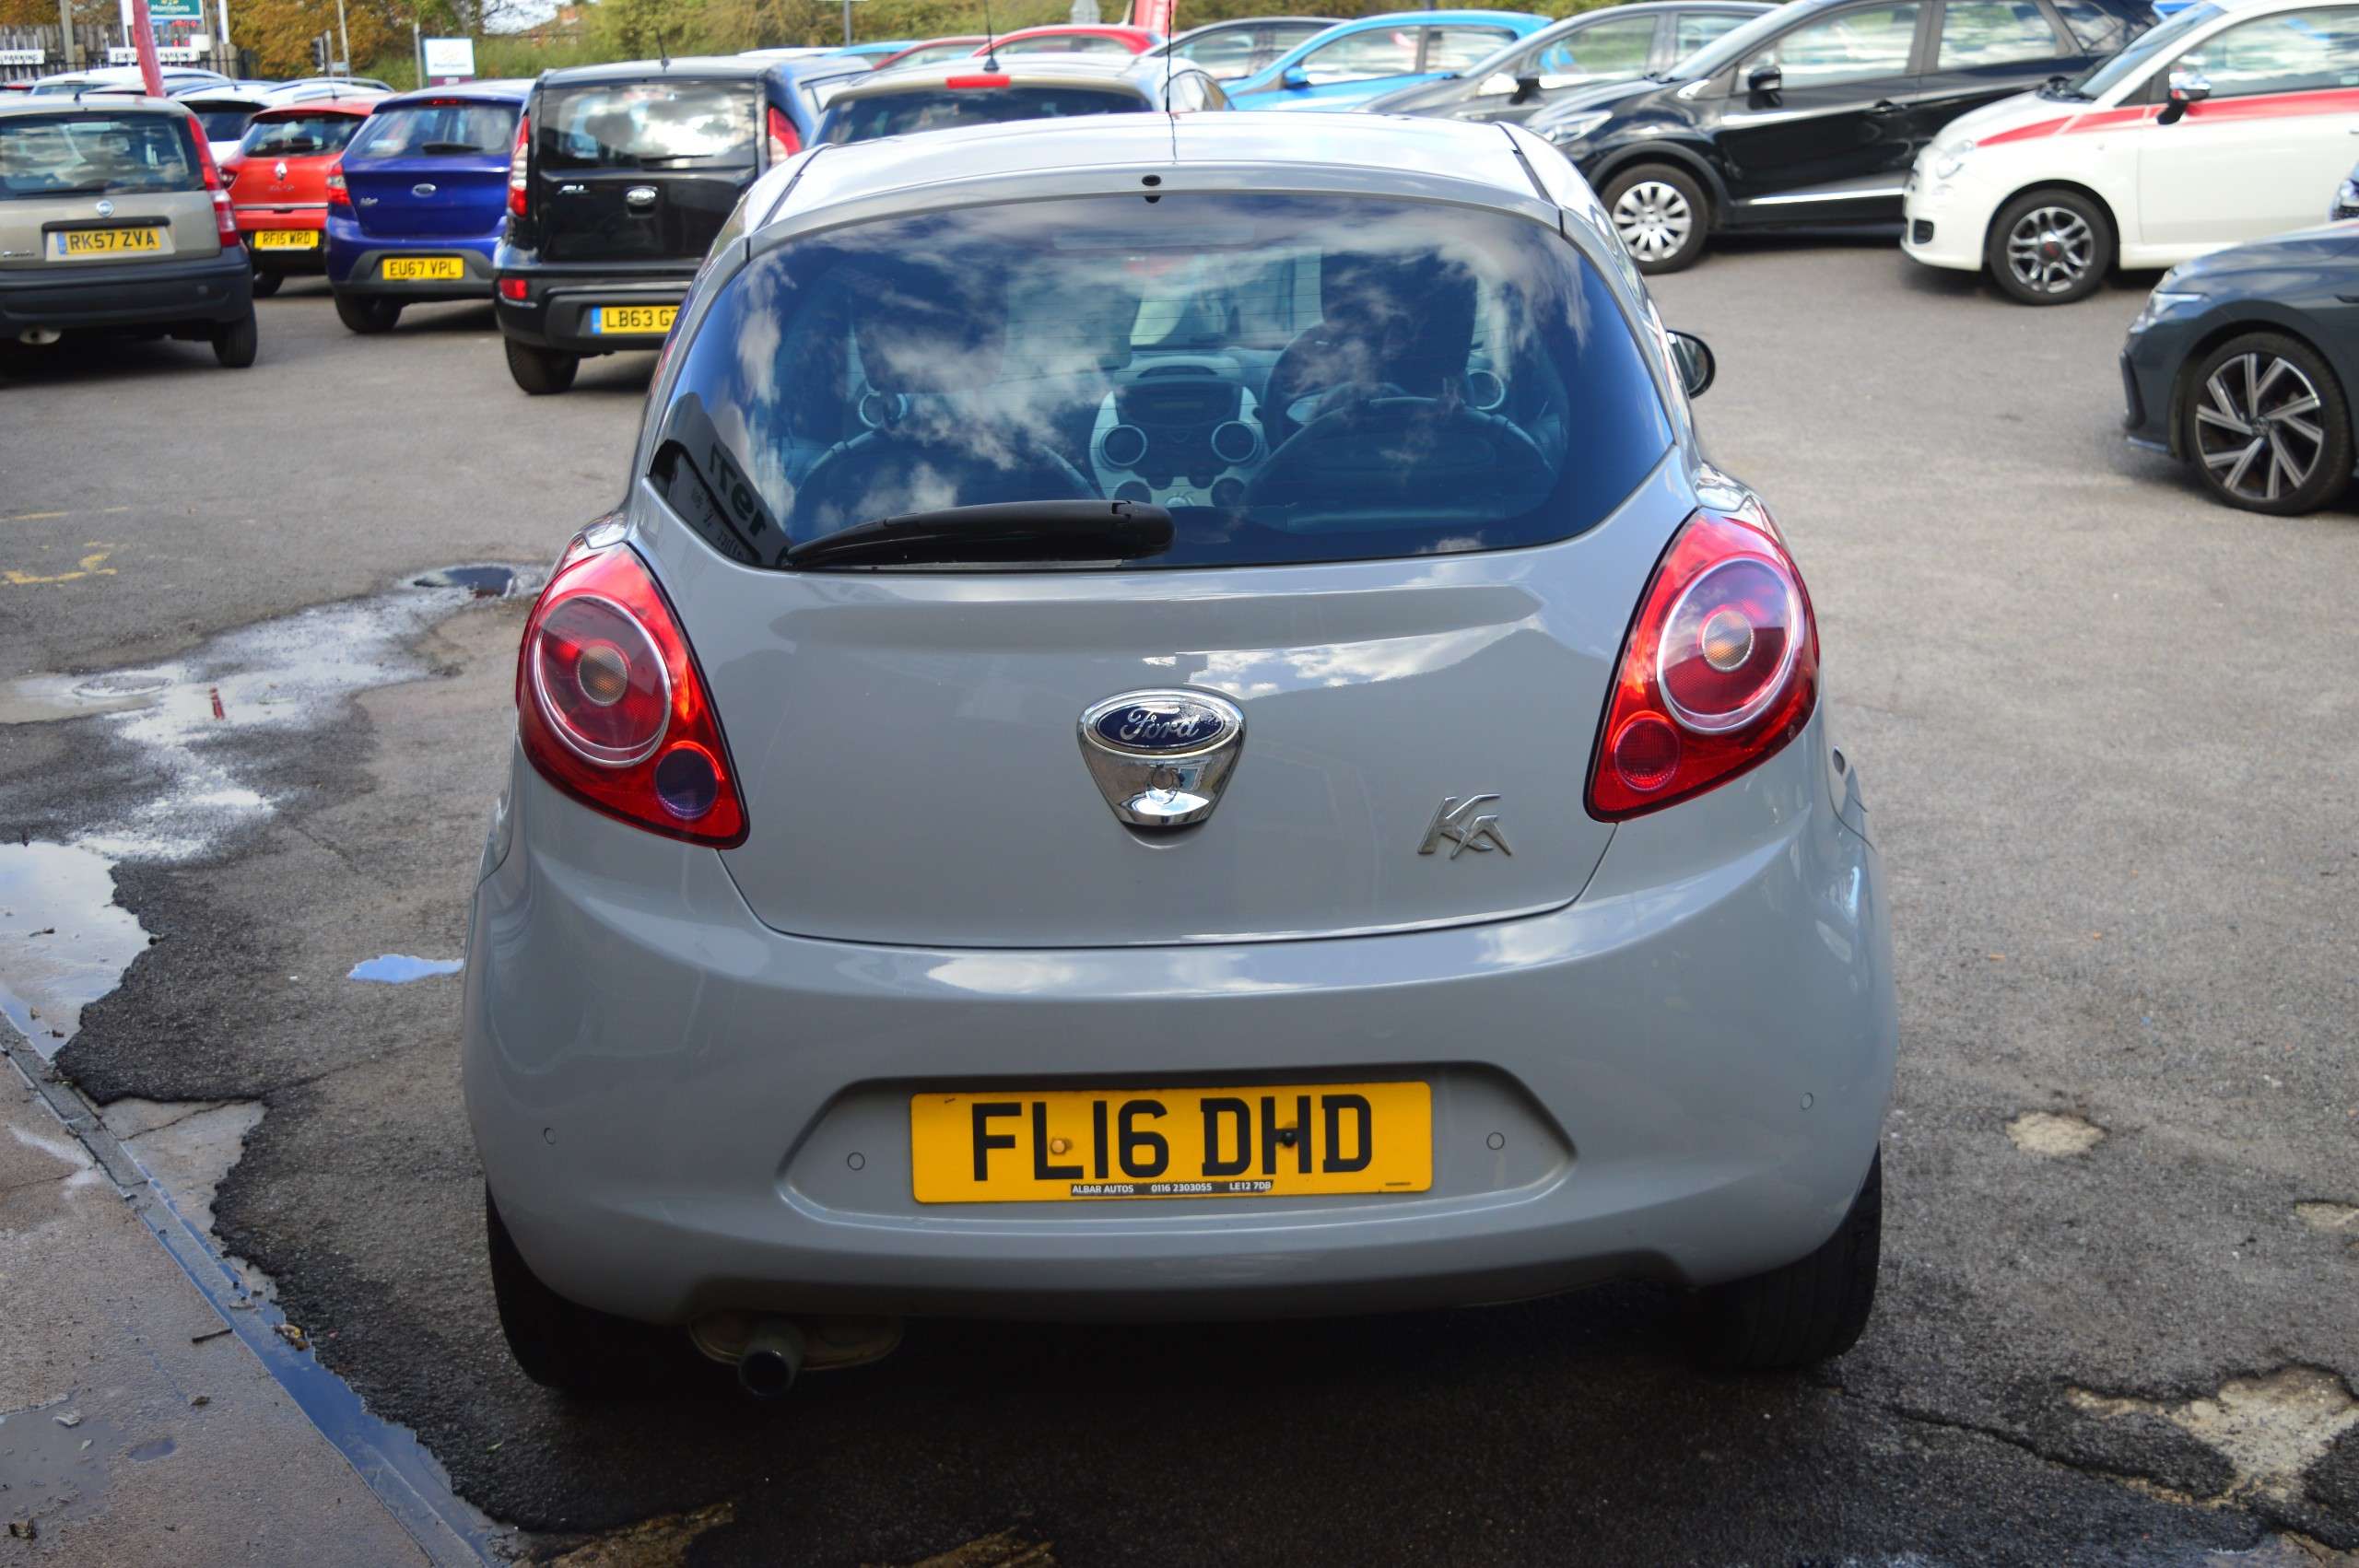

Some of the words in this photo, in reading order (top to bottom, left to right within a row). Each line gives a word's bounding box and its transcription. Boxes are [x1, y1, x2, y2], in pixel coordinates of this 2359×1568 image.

[69, 232, 115, 251] RK57
[123, 230, 156, 248] ZVA
[263, 232, 287, 245] RF15
[390, 261, 425, 276] EU67
[430, 260, 456, 275] VPL
[605, 310, 653, 328] LB63
[1120, 707, 1201, 742] Ford
[971, 1098, 1169, 1182] FL16
[1201, 1094, 1373, 1176] DHD
[1072, 1185, 1102, 1194] ALBAR
[1103, 1185, 1134, 1194] AUTOS
[1151, 1183, 1171, 1193] 0116
[1172, 1183, 1213, 1193] 2303055
[1228, 1182, 1250, 1191] LE12
[1252, 1181, 1272, 1190] 7DB
